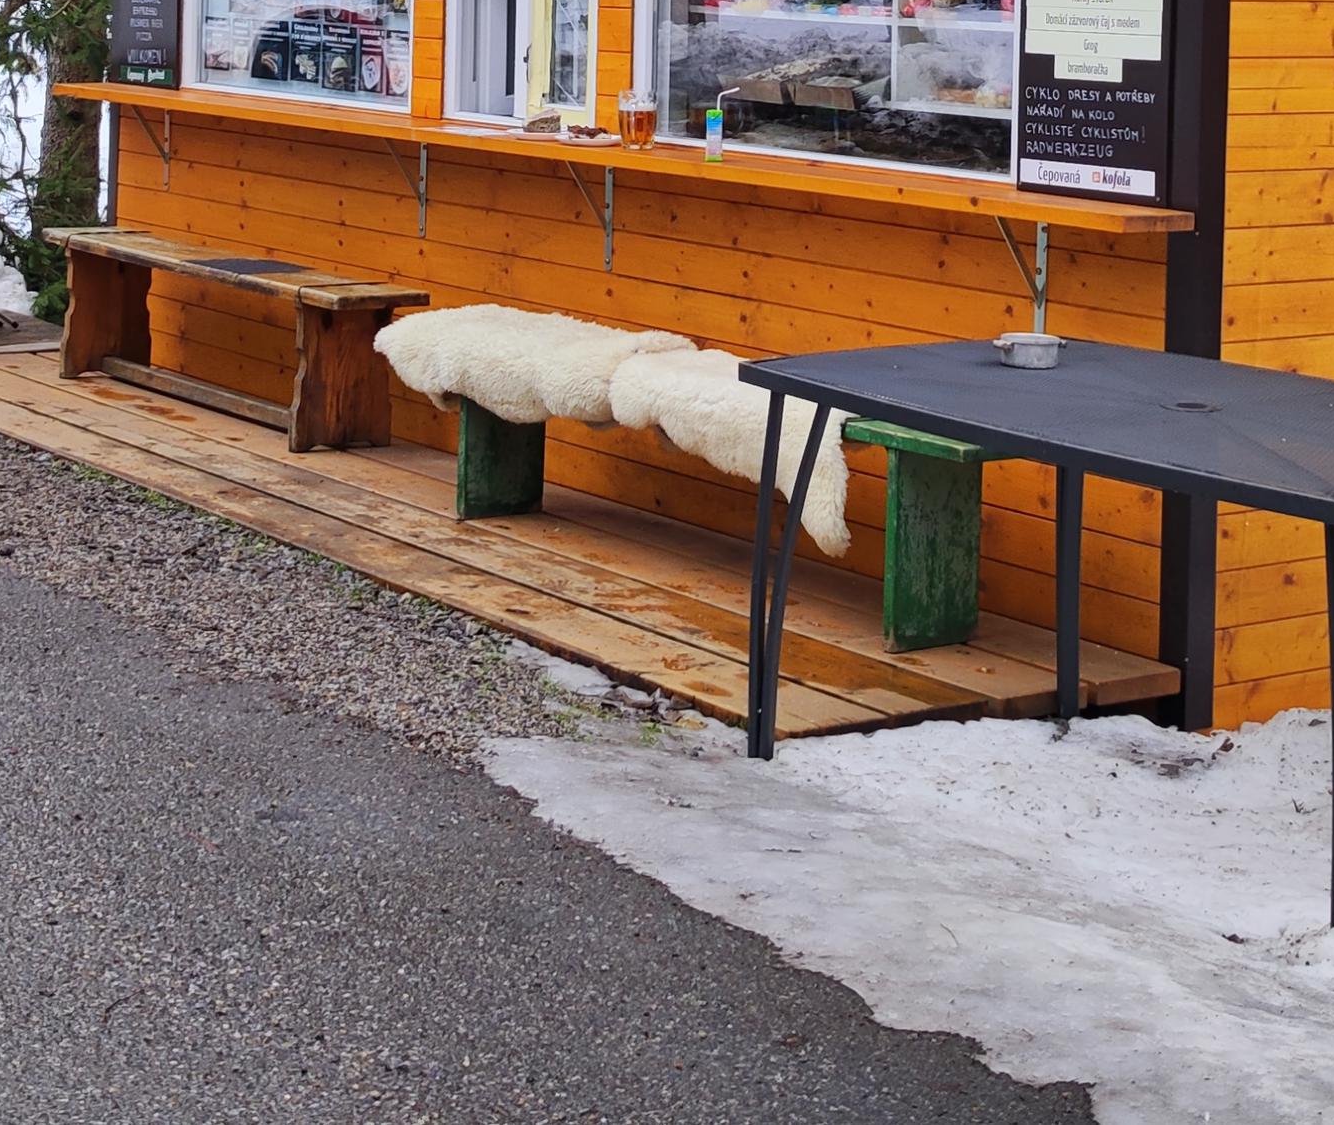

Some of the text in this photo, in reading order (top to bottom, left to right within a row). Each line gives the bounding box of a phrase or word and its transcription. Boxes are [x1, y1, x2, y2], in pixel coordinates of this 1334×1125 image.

[1045, 13, 1068, 25] Domácí
[1069, 14, 1099, 29] zázvorový
[1116, 17, 1140, 29] medem
[1084, 39, 1099, 54] Grog
[1068, 60, 1108, 75] bramboračka
[1025, 86, 1156, 104] CYKLO DRESY A POTŘEBY
[1026, 103, 1115, 121] NÁŘADÍ NA KOLO
[1025, 122, 1076, 137] CYKLISTÉ
[1026, 140, 1114, 158] RADWERKZEUG
[1037, 162, 1131, 189] Čepovaná kofola
